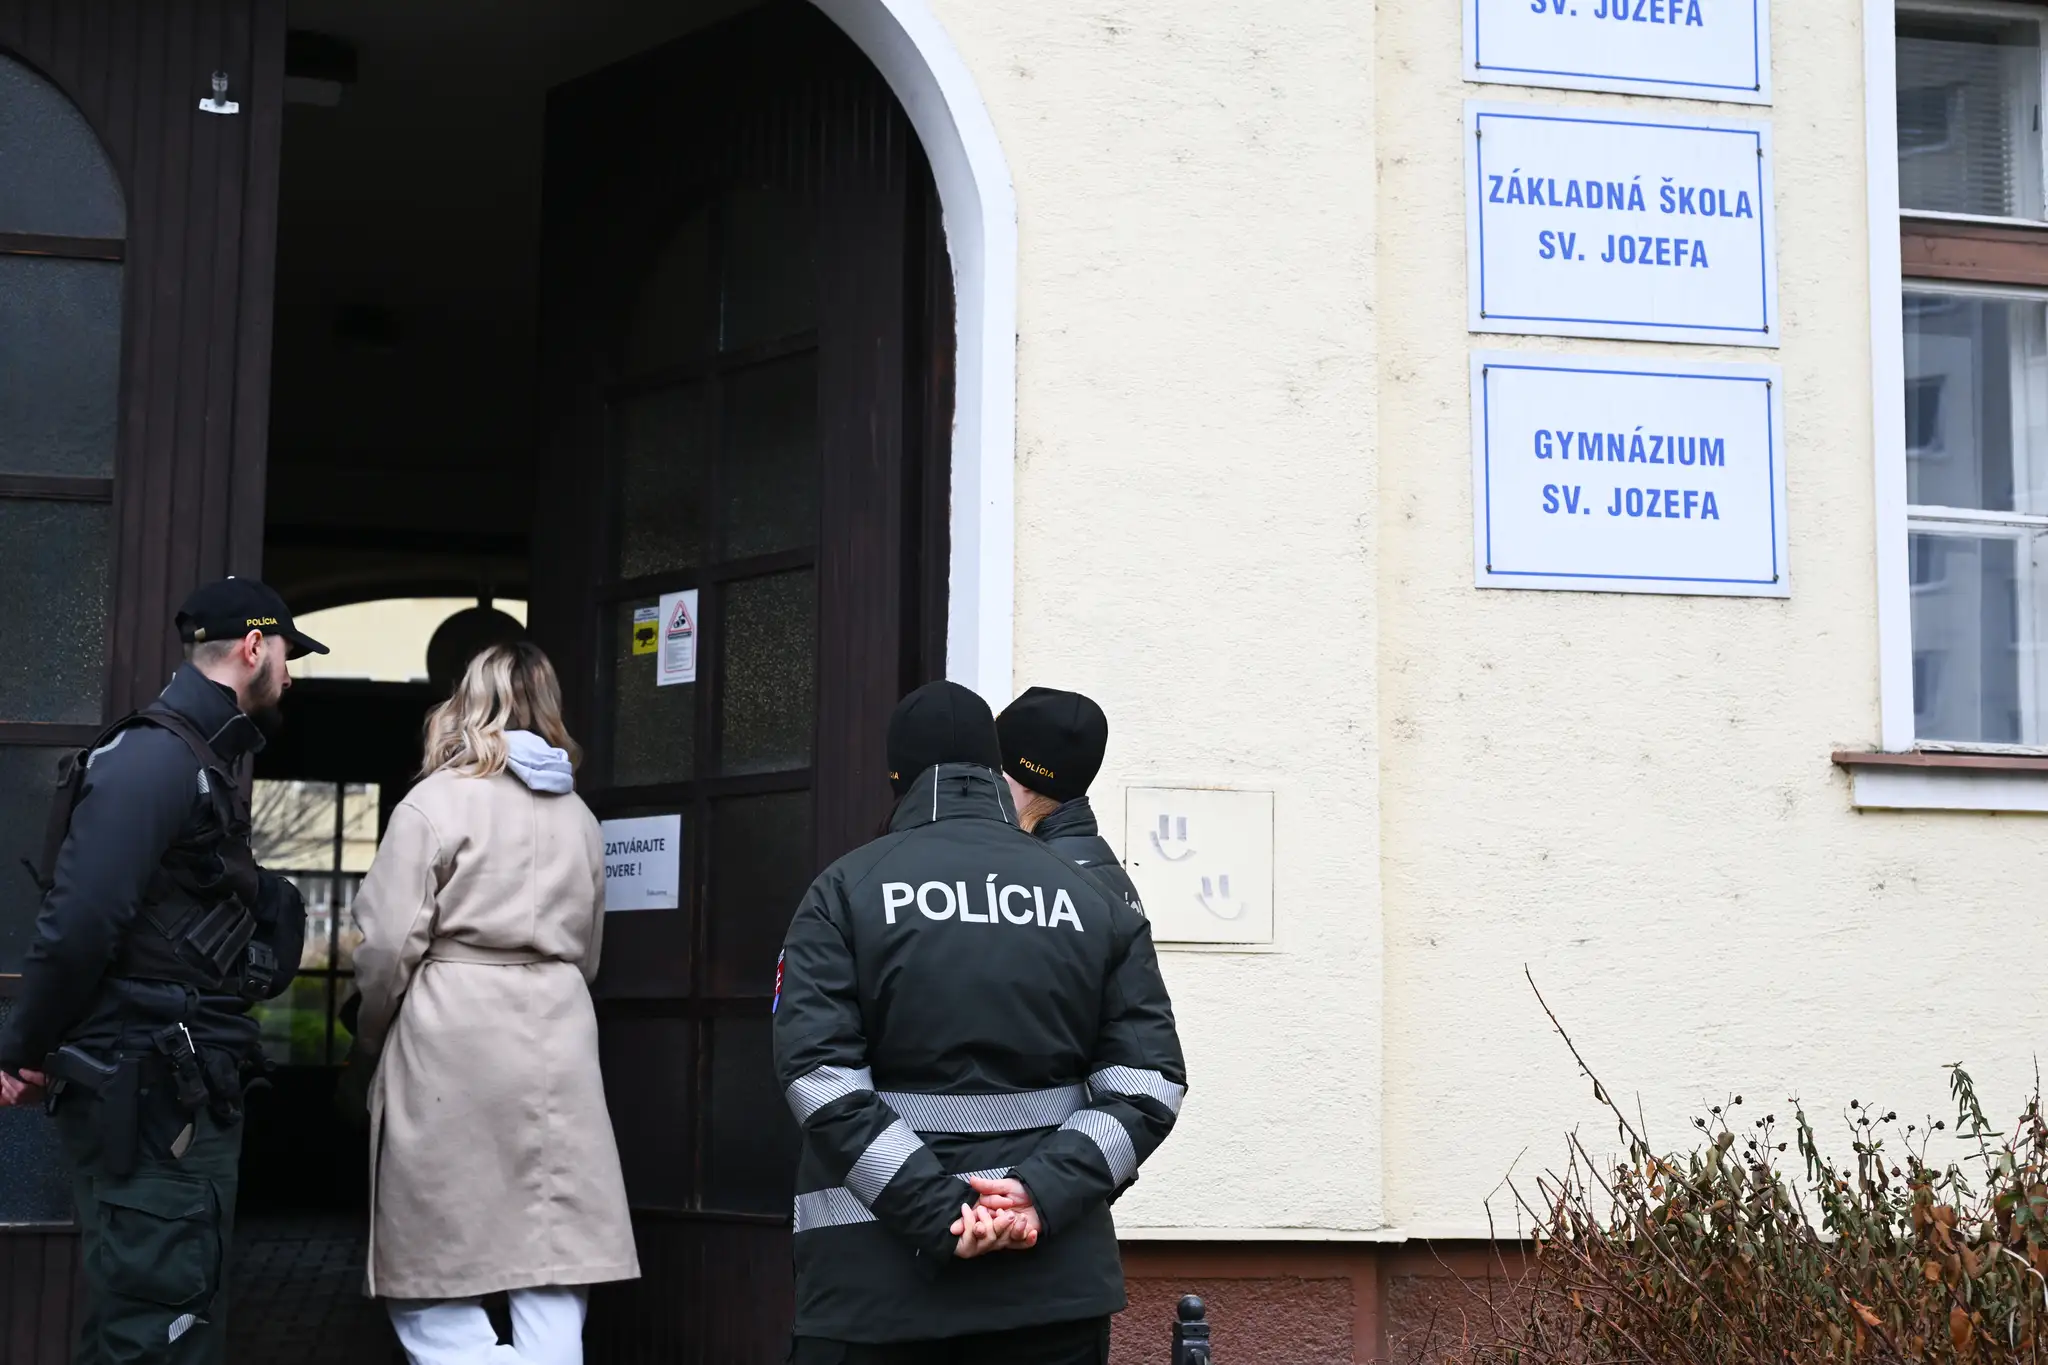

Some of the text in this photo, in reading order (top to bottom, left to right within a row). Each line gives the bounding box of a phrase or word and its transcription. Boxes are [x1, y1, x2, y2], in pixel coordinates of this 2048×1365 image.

[1594, 0, 1704, 26] JOZEFA
[1488, 168, 1753, 219] ZÁKLADNÁ ŠKOLA
[1538, 230, 1709, 268] SV. JOZEFA
[1534, 425, 1725, 467] GYMNÁZIUM
[1542, 484, 1720, 520] SV. JOZEFA
[246, 616, 278, 627] POLÍCIA
[1019, 757, 1054, 779] POLÍCIA
[605, 837, 665, 856] ZATVÁRAJTE
[882, 873, 1084, 932] POLÍCIA
